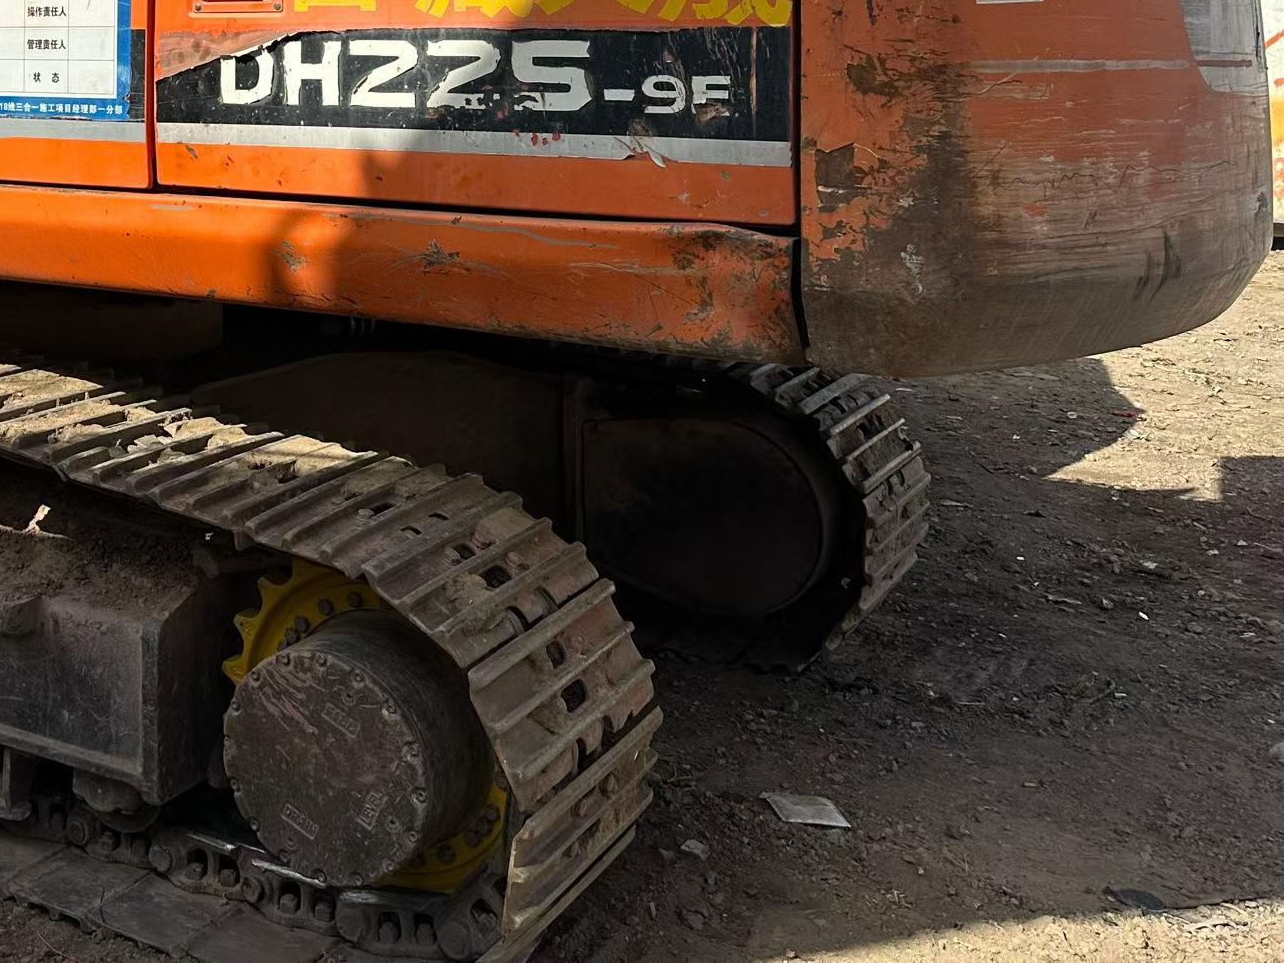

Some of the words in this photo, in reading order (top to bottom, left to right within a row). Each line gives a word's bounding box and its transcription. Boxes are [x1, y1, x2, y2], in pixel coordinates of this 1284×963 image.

[27, 6, 67, 18] 操作责任人
[27, 38, 66, 50] 管理责任人
[33, 71, 60, 83] 状态
